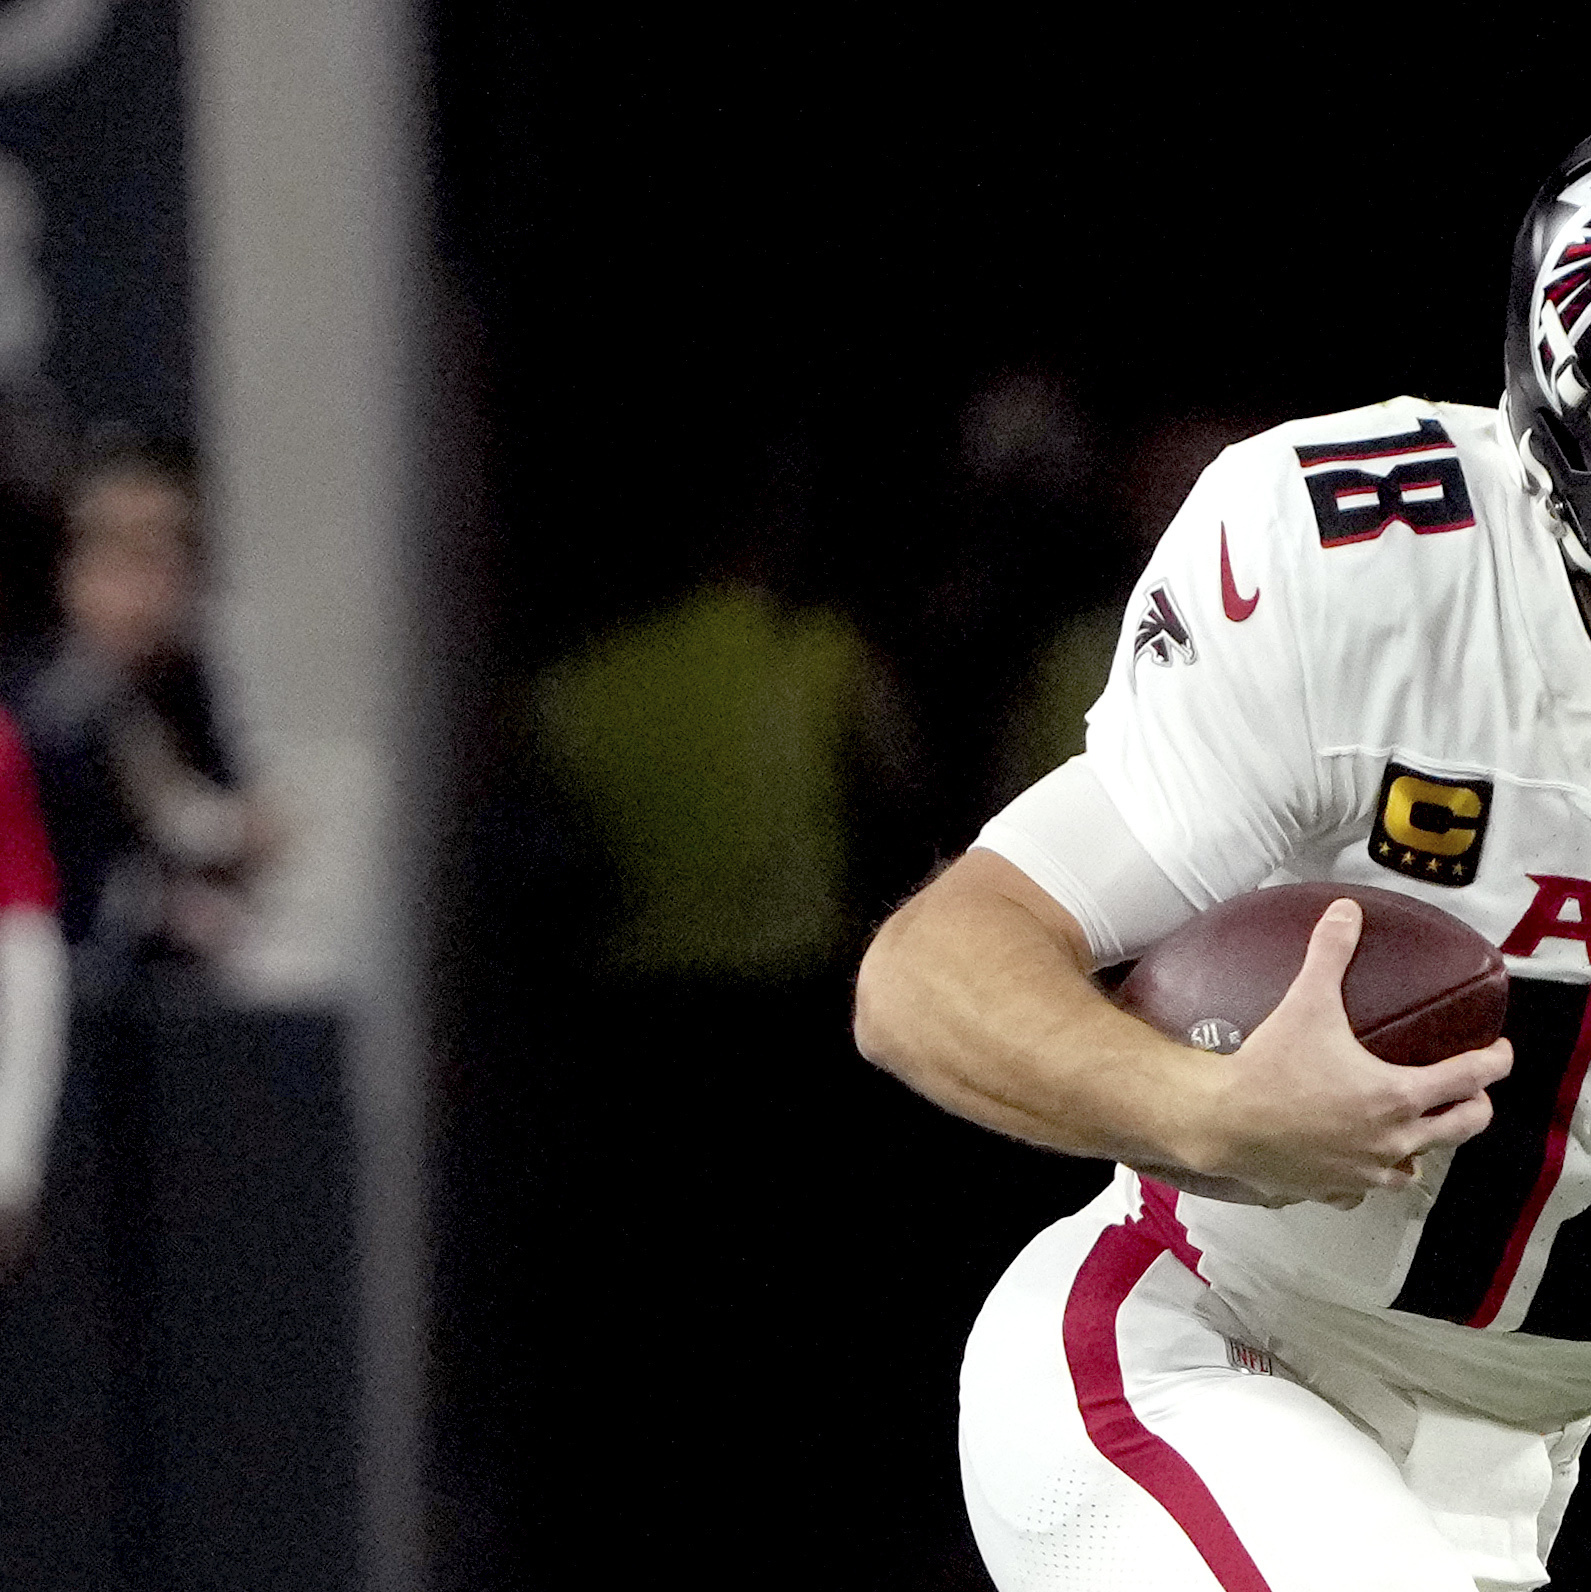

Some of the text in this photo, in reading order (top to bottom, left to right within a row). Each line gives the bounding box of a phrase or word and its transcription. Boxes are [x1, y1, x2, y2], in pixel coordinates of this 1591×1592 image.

[1293, 417, 1476, 549] 18
[1384, 776, 1481, 856] C
[1233, 1344, 1269, 1373] NFL
